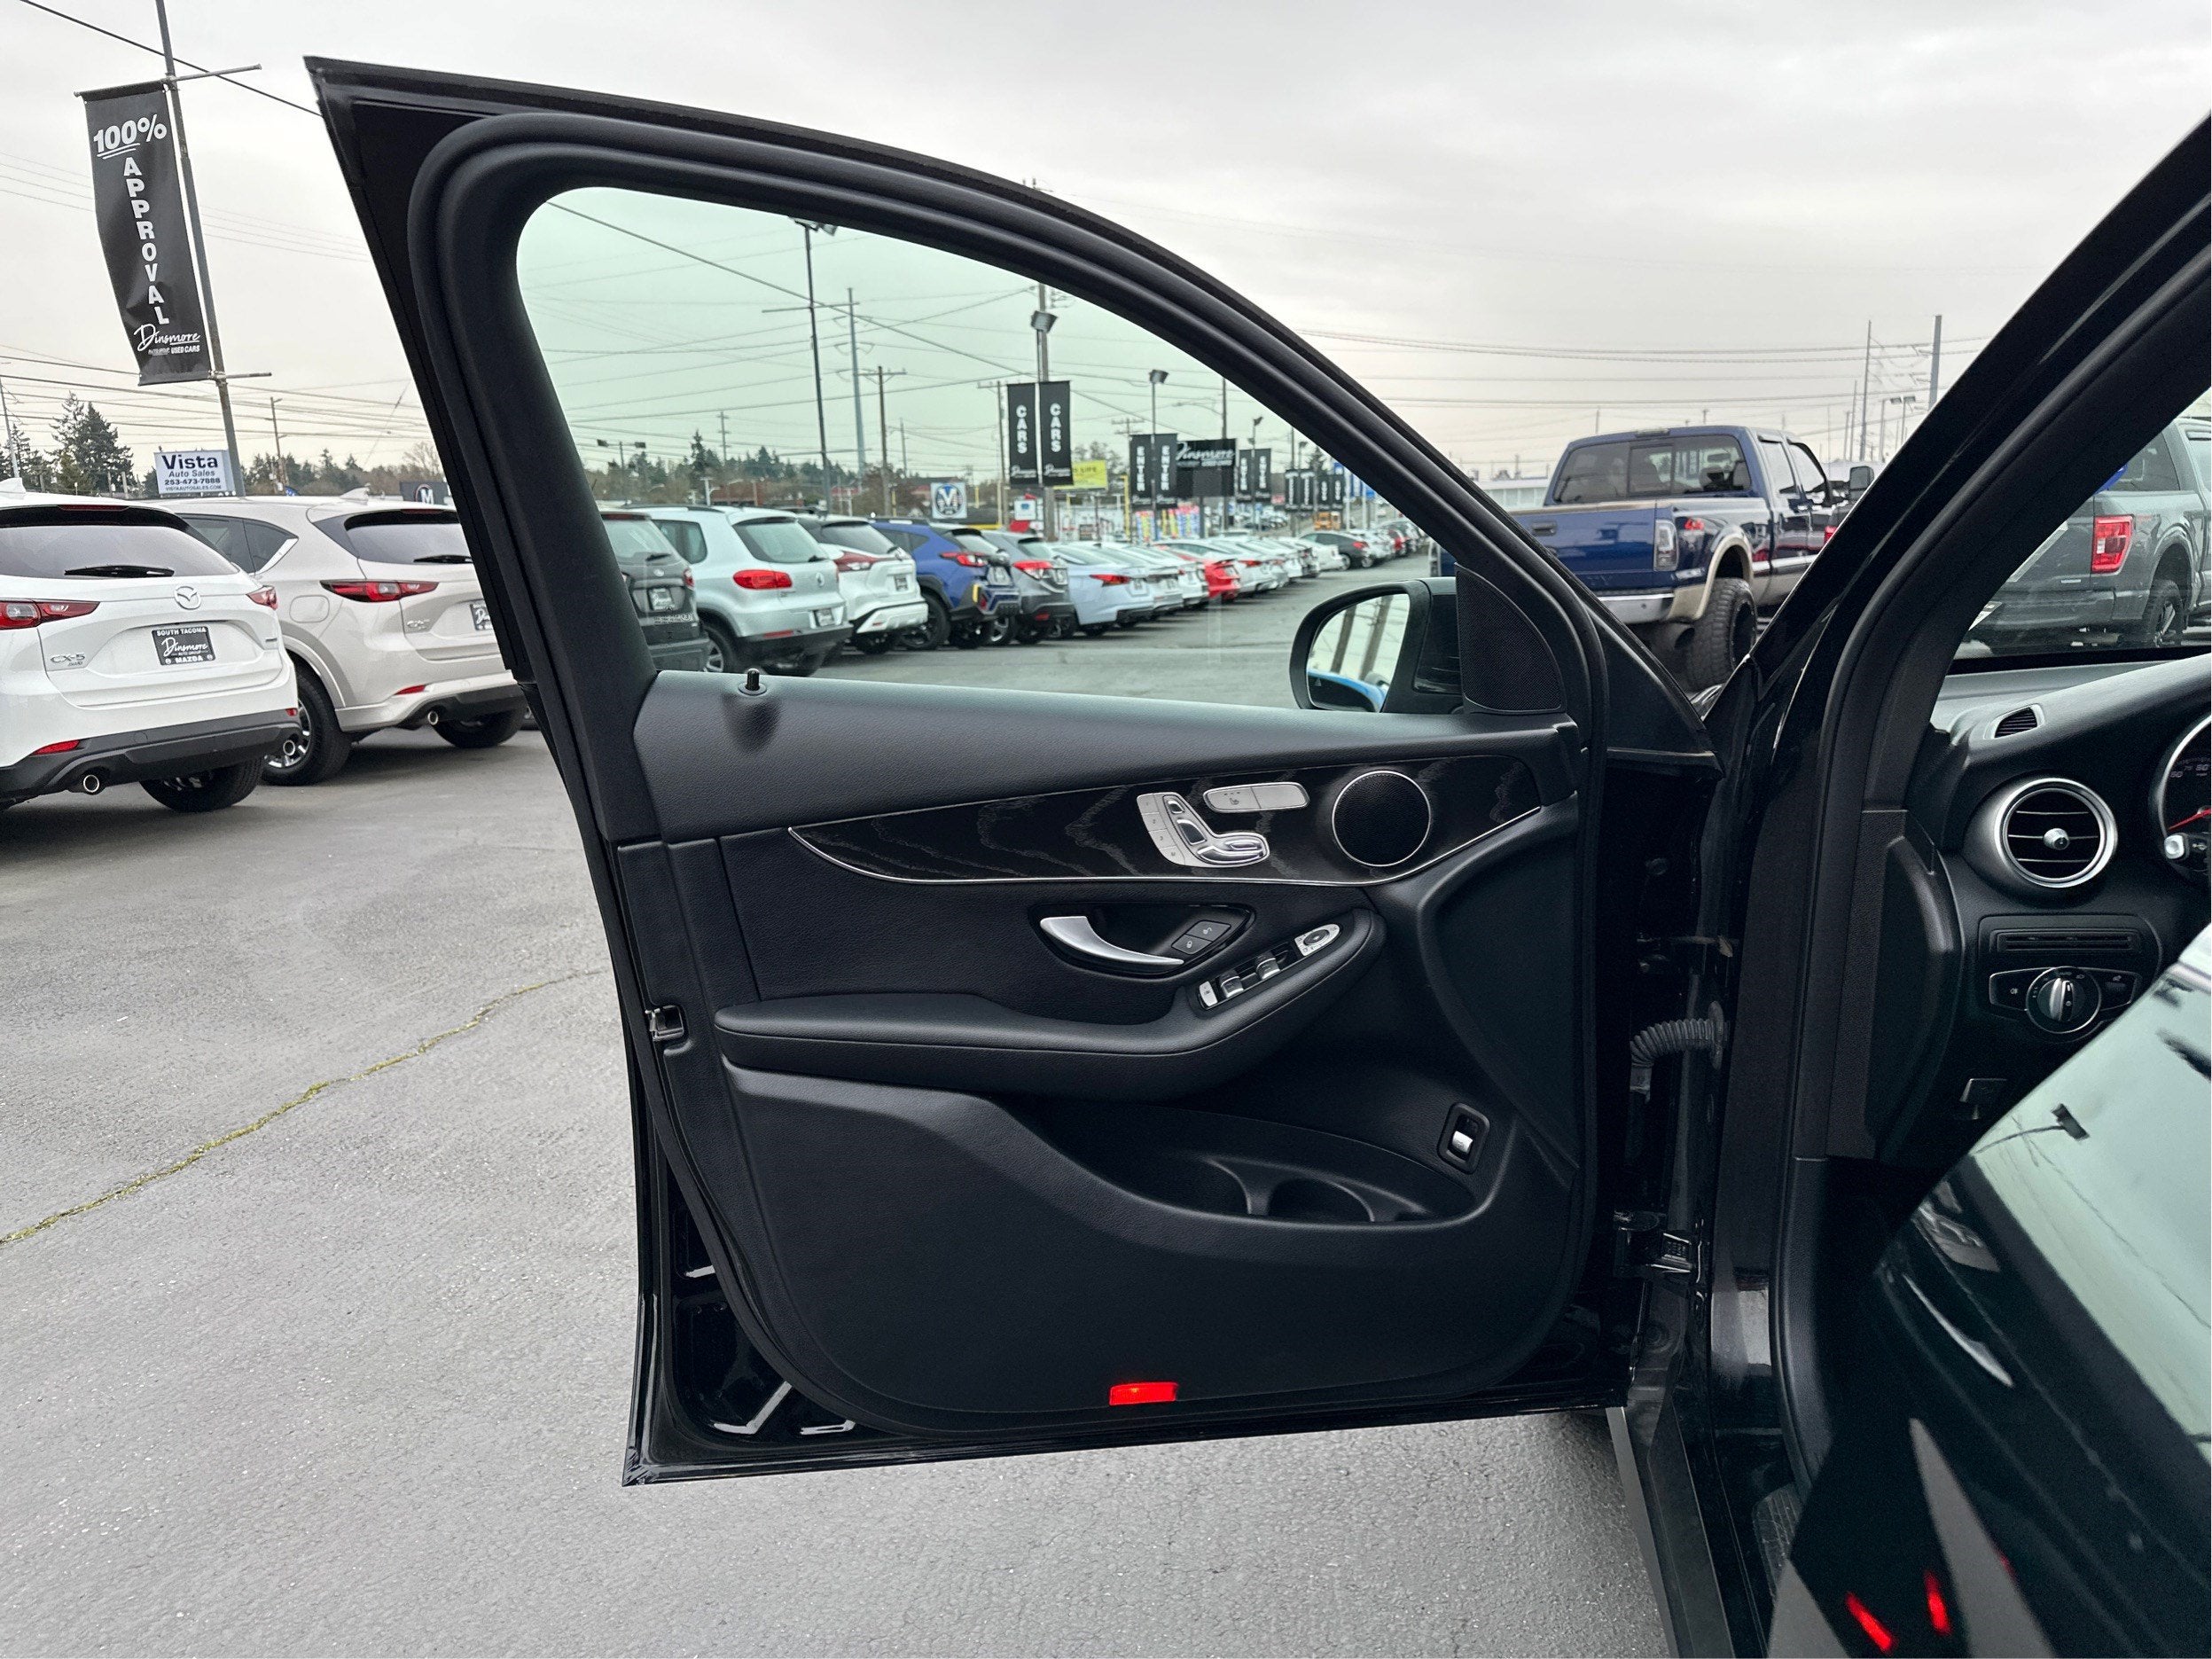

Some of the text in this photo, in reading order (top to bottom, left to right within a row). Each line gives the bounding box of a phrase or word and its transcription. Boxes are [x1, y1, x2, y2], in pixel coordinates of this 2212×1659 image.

[93, 113, 168, 153] 100%
[123, 156, 170, 325] APPROVAL
[133, 324, 200, 352] Dinsmore
[170, 346, 184, 355] USED
[184, 345, 200, 354] CARS
[1016, 404, 1028, 454] CARS
[1050, 403, 1062, 453] CARS
[161, 454, 219, 470] Vista
[1136, 445, 1145, 491] ENTER
[1161, 445, 1170, 491] ENTER
[180, 626, 207, 635] TACOMA
[50, 652, 86, 663] CX-5
[161, 637, 208, 657] Dinsmore
[175, 655, 204, 664] MAZDA
